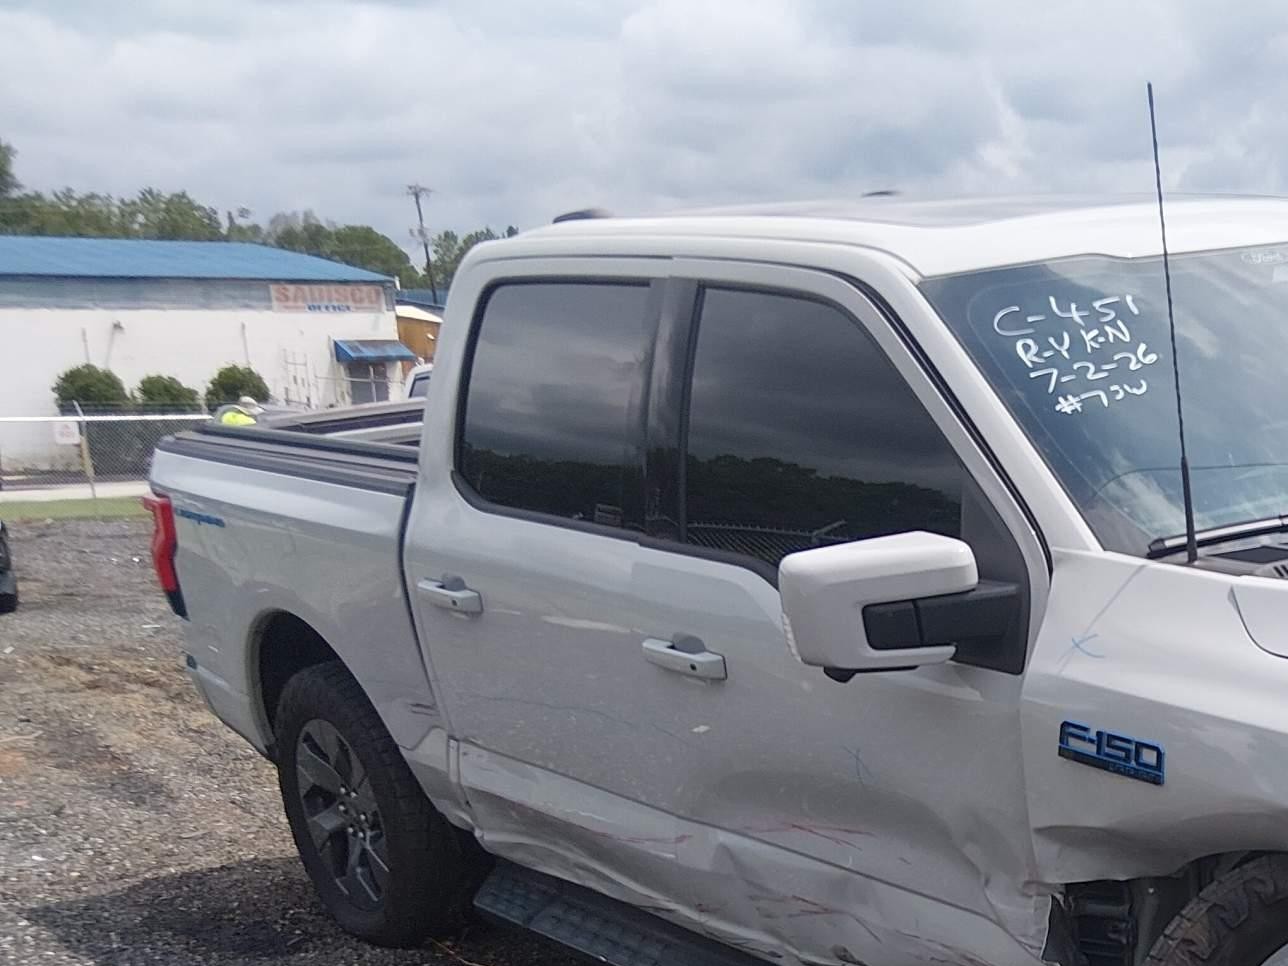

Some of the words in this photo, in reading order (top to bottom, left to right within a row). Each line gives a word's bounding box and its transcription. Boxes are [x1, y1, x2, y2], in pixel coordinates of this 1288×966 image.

[993, 294, 1140, 336] C-451
[1029, 343, 1158, 393] 7-2-26
[1058, 720, 1165, 772] F-150
